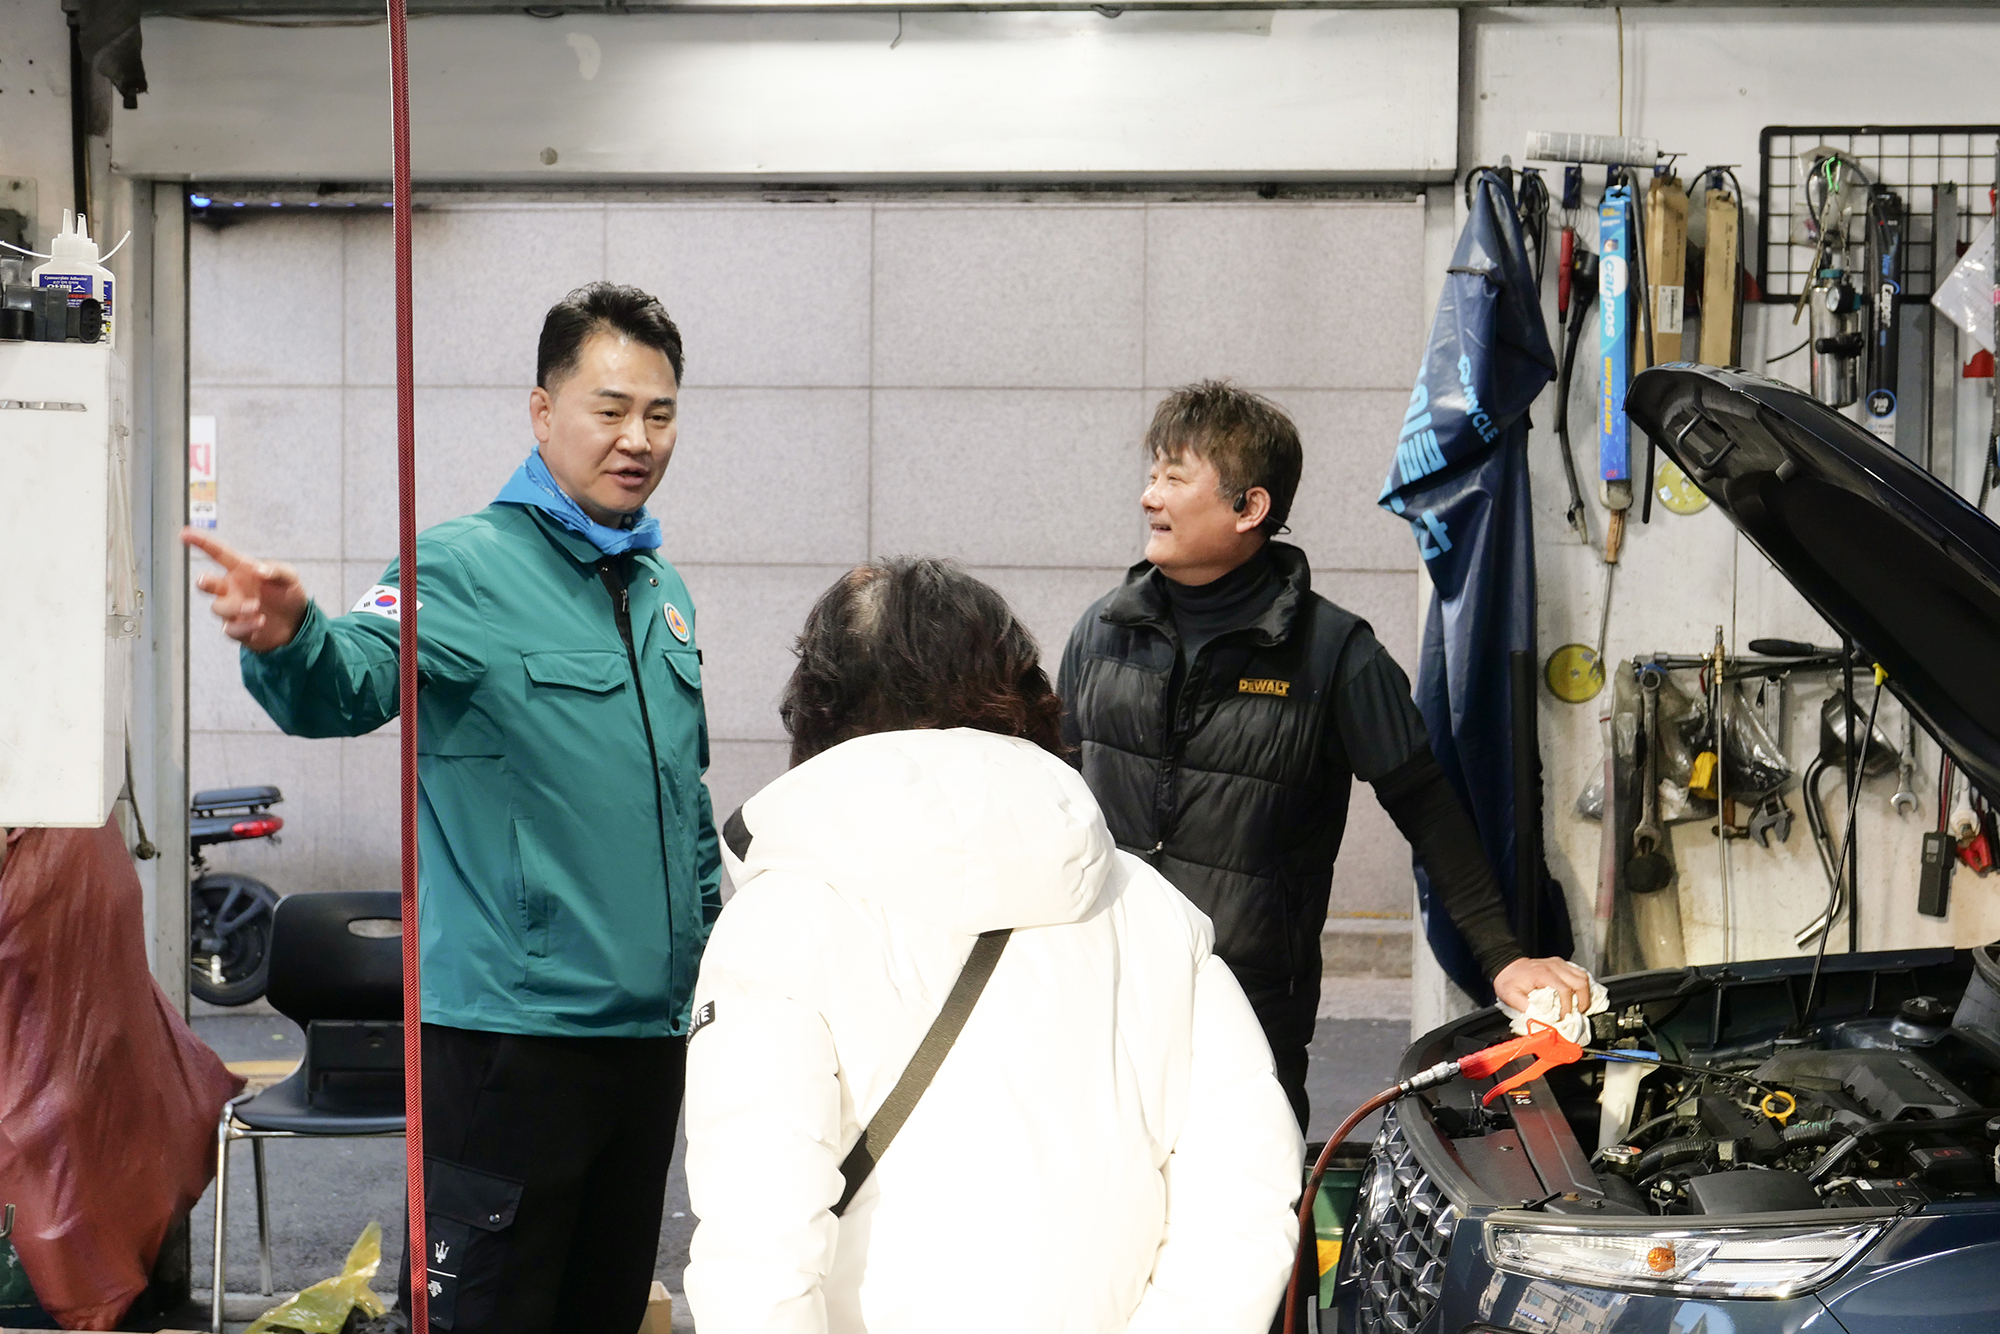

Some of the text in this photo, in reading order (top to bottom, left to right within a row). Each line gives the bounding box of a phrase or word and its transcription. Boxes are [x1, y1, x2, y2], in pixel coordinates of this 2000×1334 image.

[1464, 385, 1499, 443] MYCLE
[1604, 356, 1613, 435] WIPER BLADE
